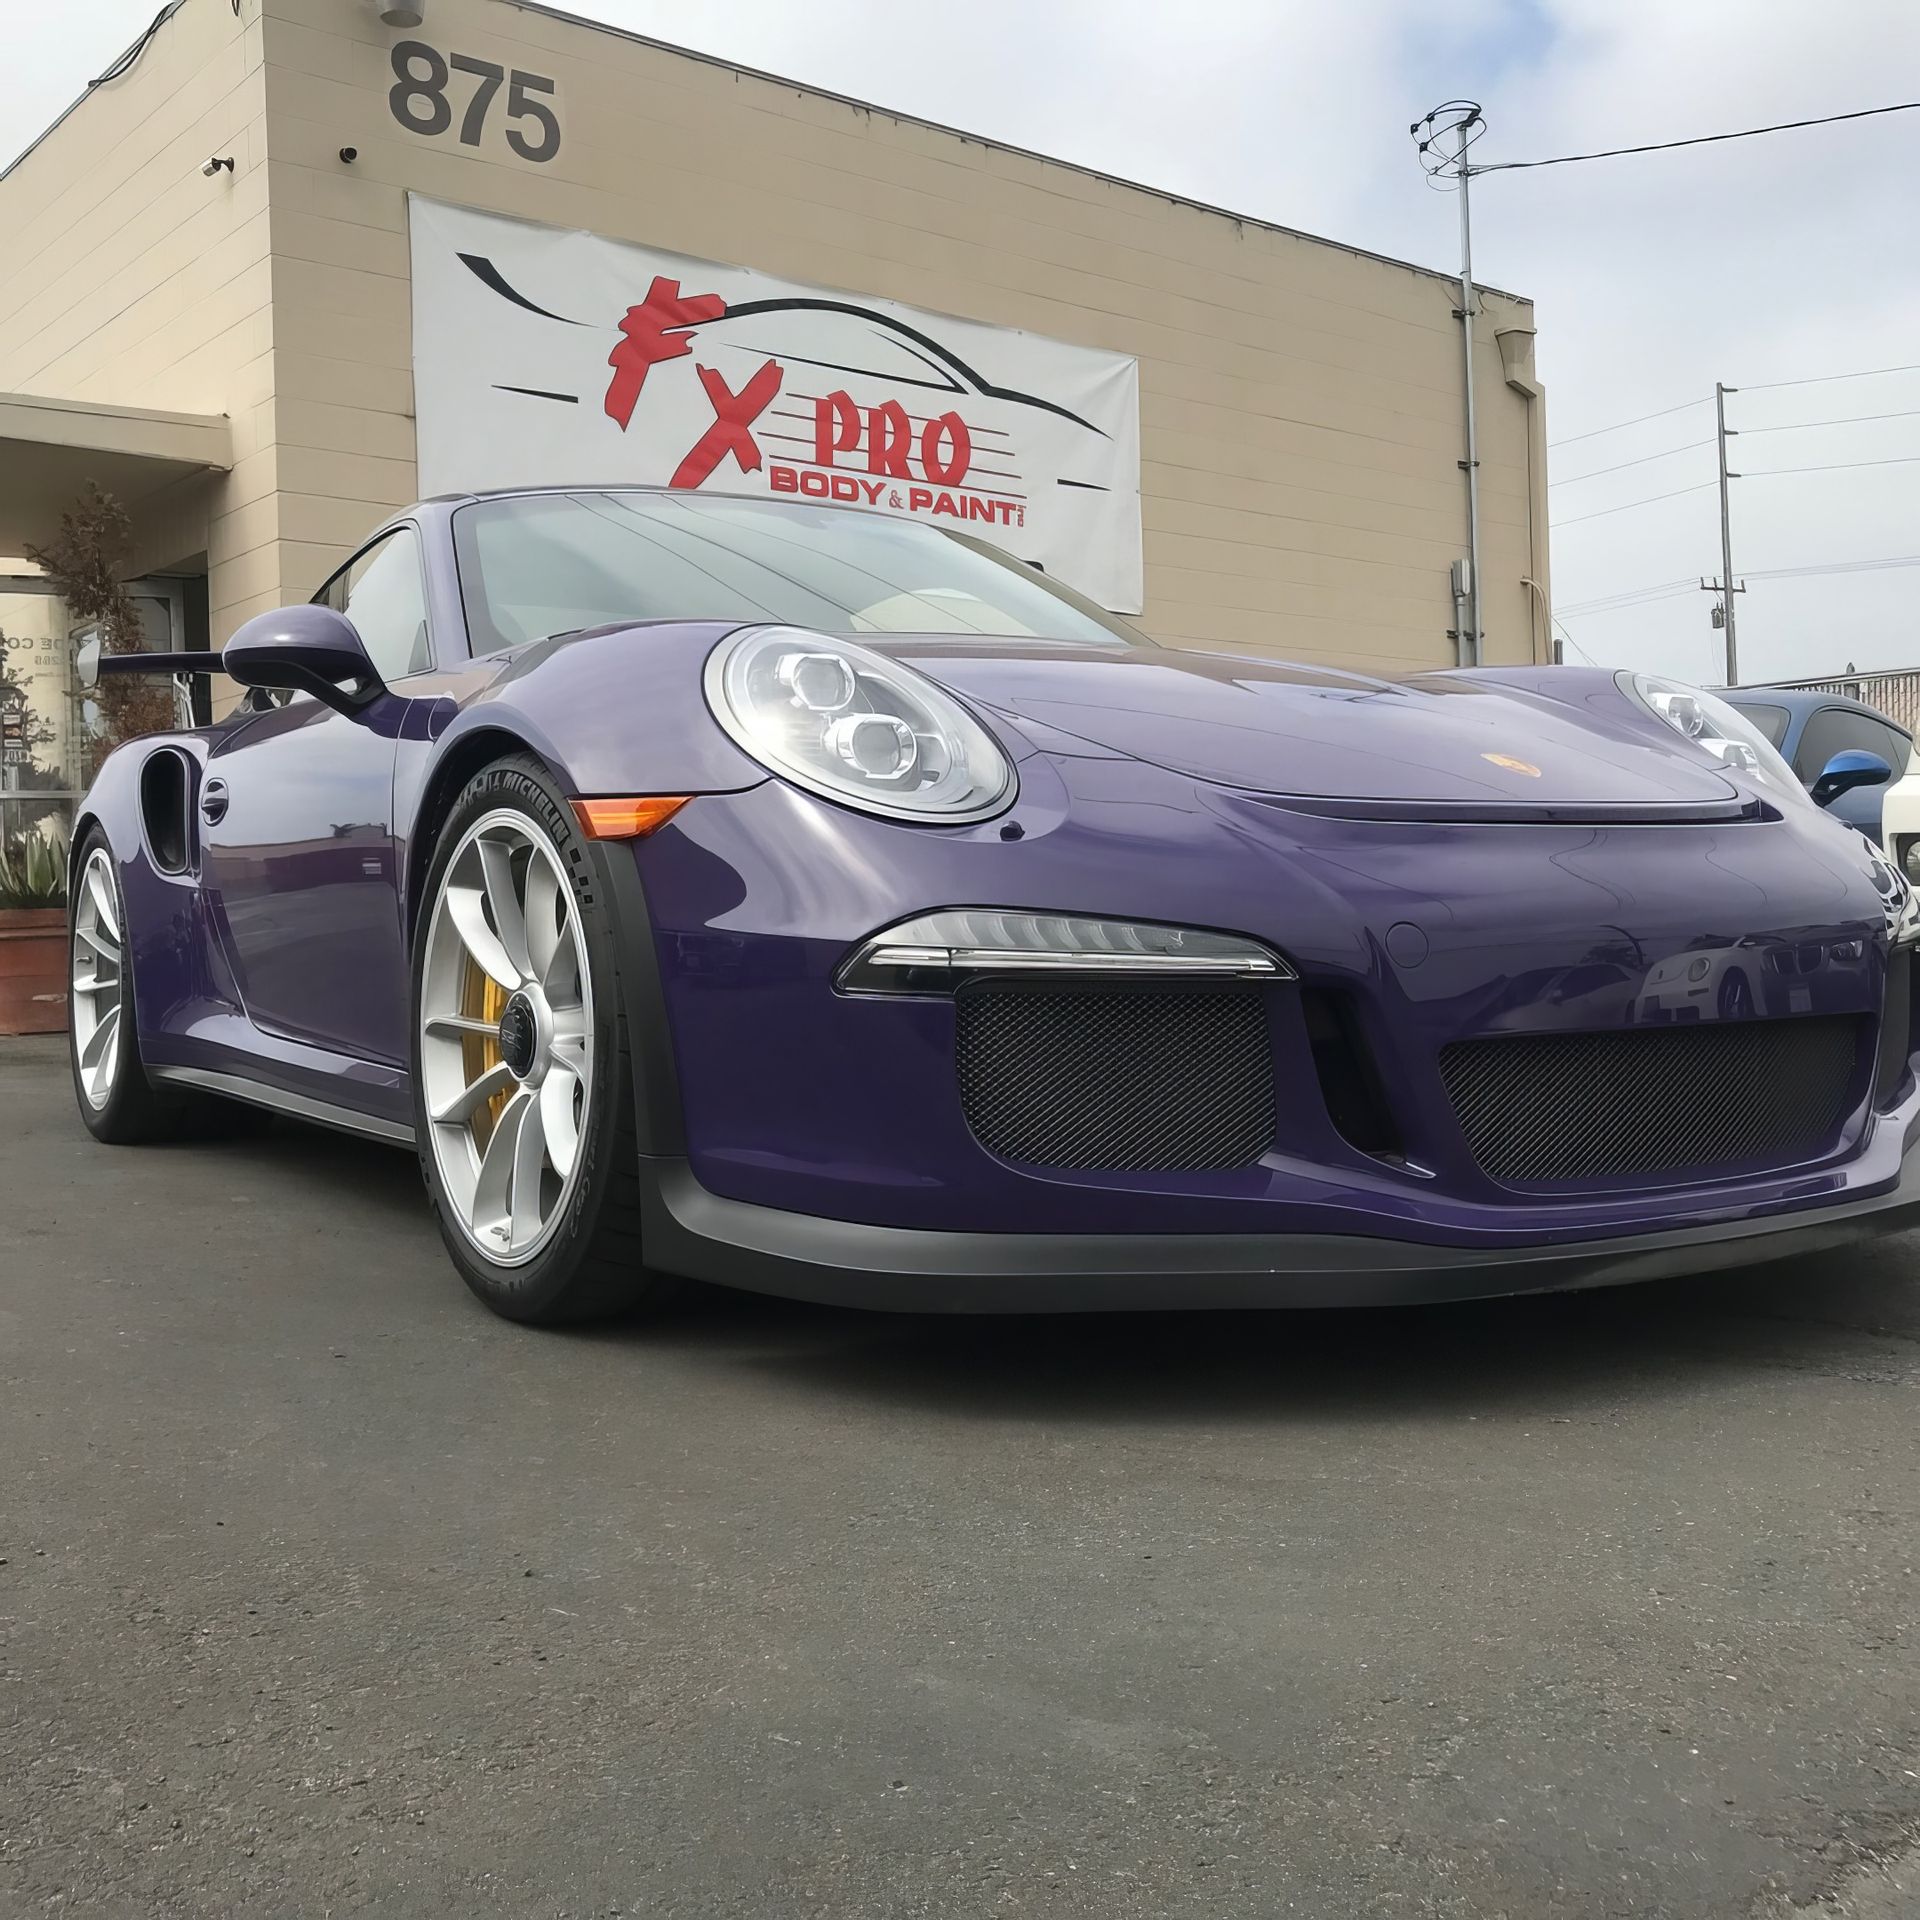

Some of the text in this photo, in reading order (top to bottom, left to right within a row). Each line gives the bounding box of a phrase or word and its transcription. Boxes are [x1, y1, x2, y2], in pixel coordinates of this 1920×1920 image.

[388, 40, 561, 163] 875
[815, 389, 971, 487] PRO
[769, 465, 888, 506] BODY
[888, 489, 905, 510] &
[908, 486, 1018, 527] PAINT
[502, 771, 571, 845] MICHELIN
